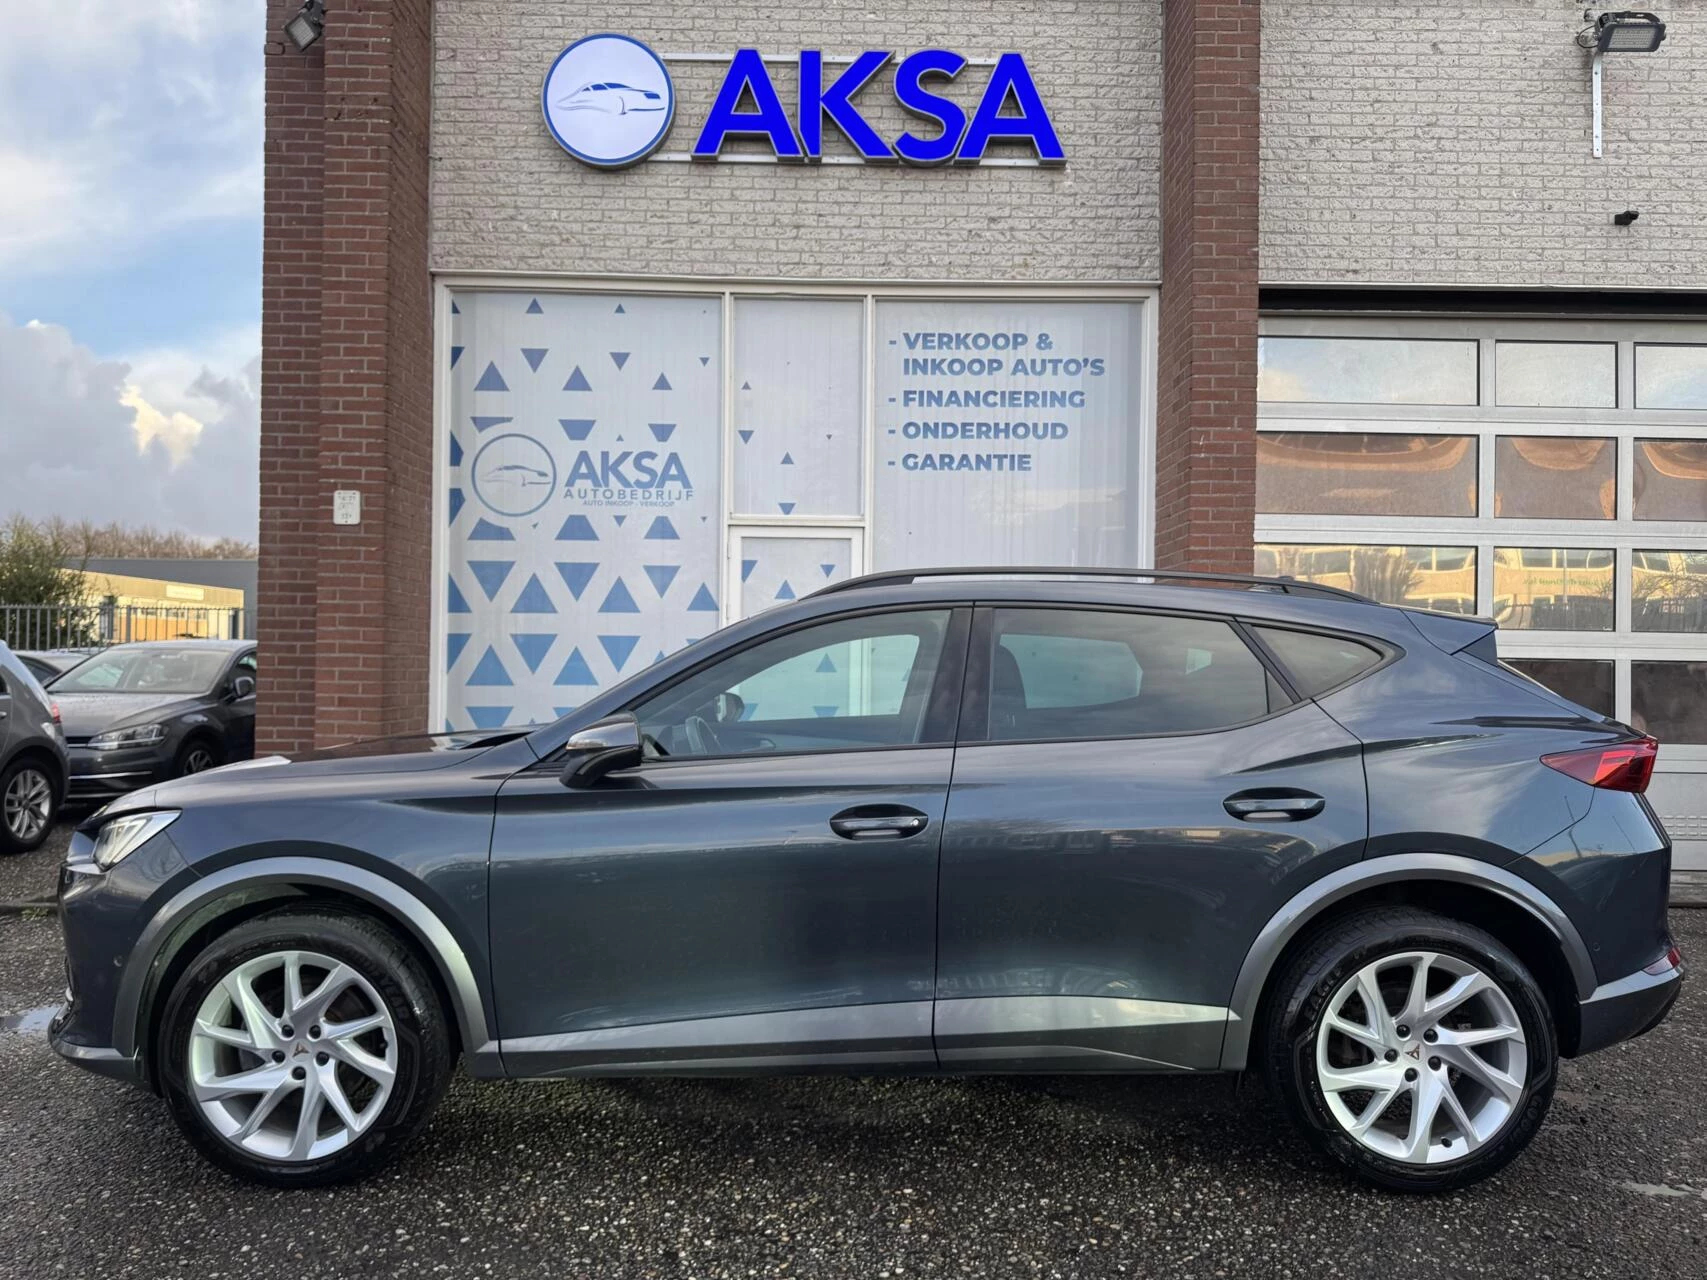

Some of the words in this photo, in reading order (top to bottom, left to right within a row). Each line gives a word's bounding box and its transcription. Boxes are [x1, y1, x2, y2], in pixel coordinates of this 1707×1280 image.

[691, 48, 1067, 166] AKSA
[902, 332, 1029, 351] VERKOOP
[1035, 332, 1054, 351] &
[903, 358, 1004, 376] INKOOP
[1010, 357, 1106, 377] AUTO'S
[902, 389, 1086, 408] FINANCIERING
[902, 421, 1069, 440] ONDERHOUD
[564, 450, 693, 489] AKSA
[901, 453, 1032, 472] GARANTIE
[563, 488, 694, 501] AUTOBEDRIJF
[640, 500, 676, 508] VERKOOP
